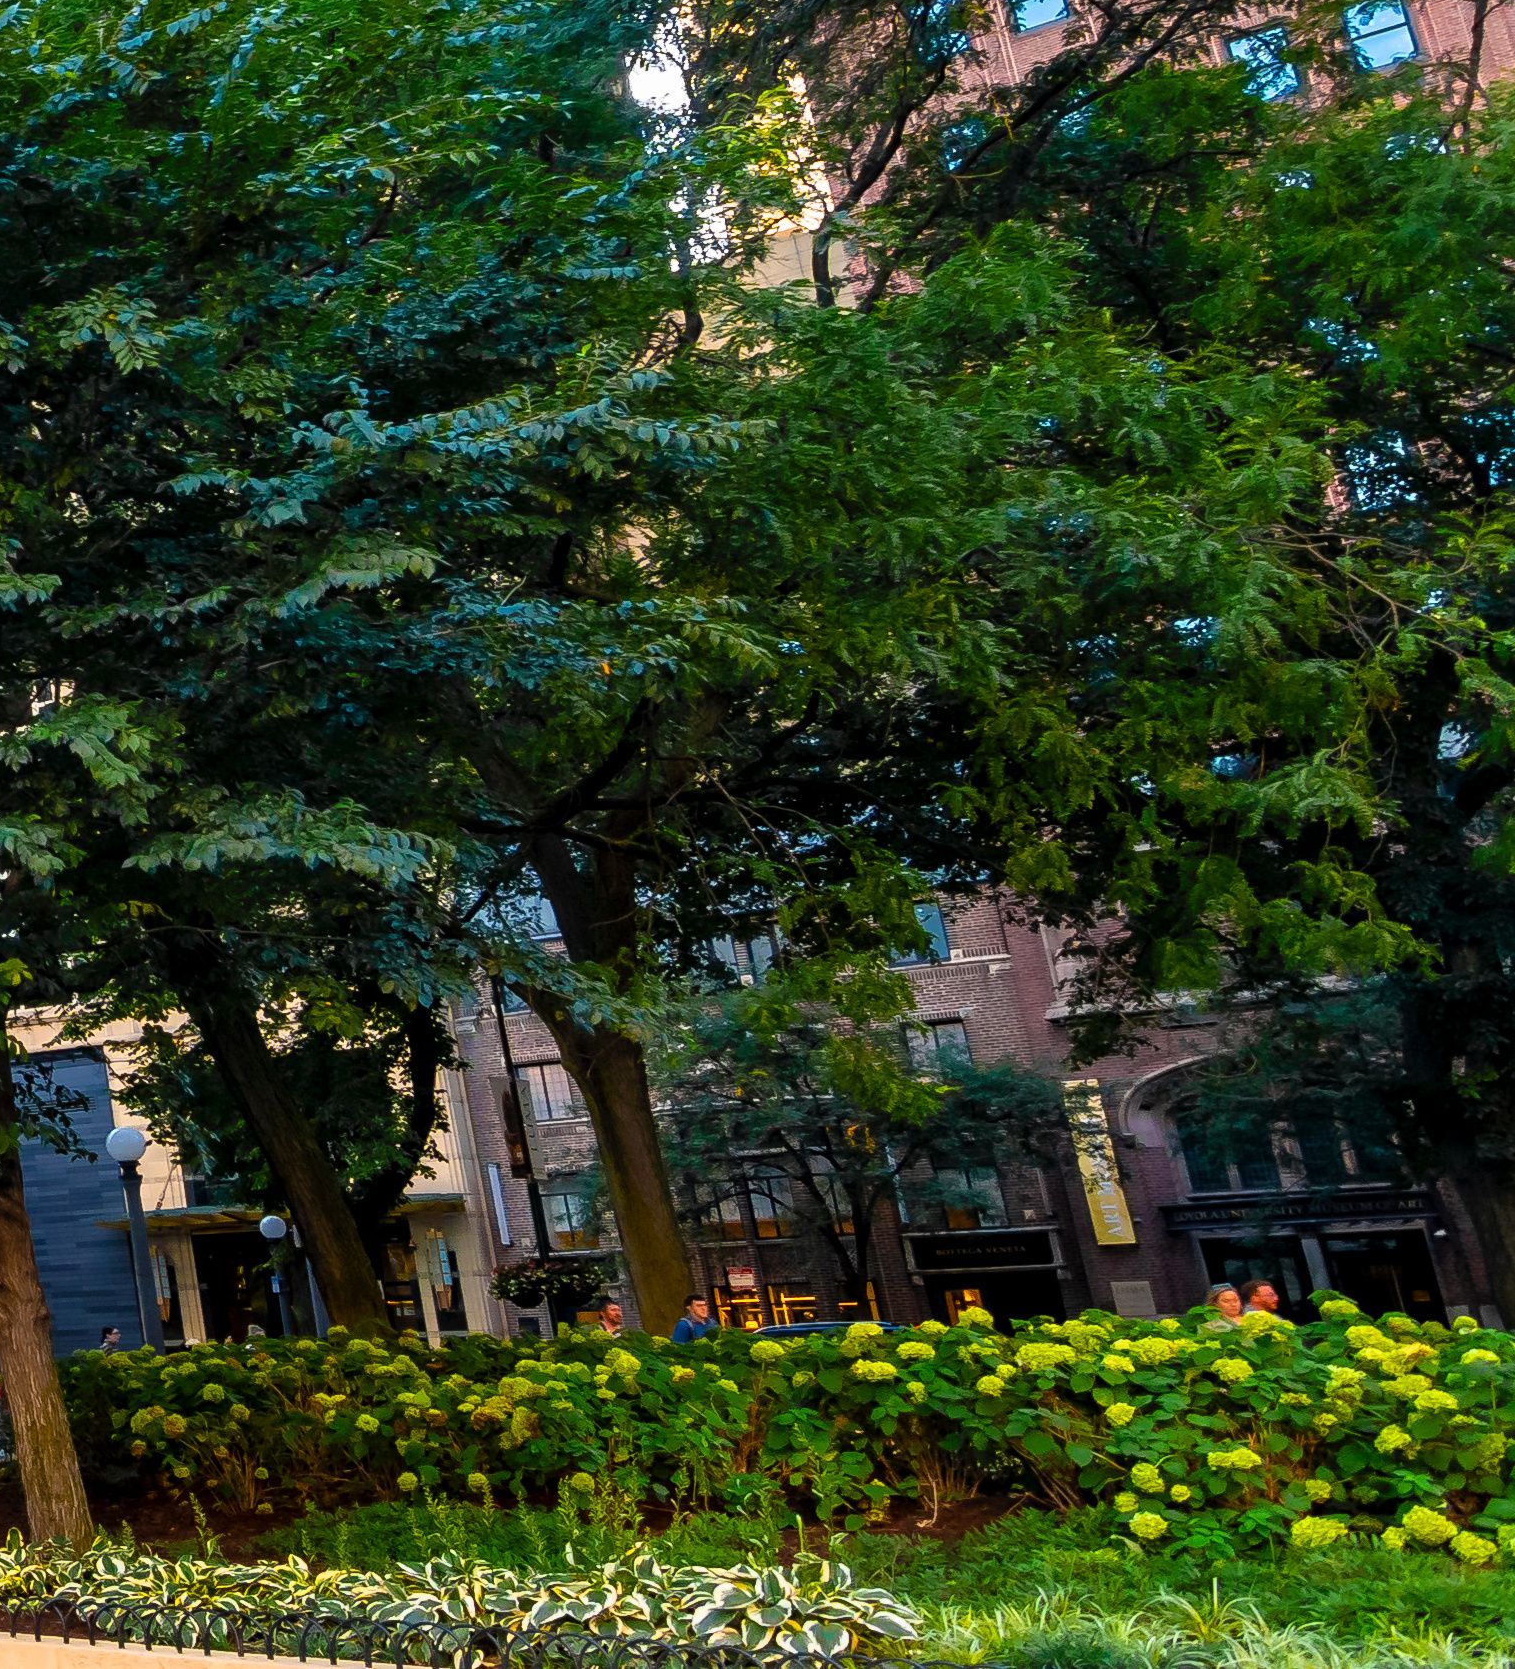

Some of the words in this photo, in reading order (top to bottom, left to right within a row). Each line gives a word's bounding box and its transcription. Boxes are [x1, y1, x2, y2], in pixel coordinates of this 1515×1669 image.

[1398, 1197, 1426, 1210] ART
[1099, 1204, 1124, 1237] ART
[936, 1247, 983, 1256] BOTTEGA
[985, 1245, 1027, 1254] VENETA
